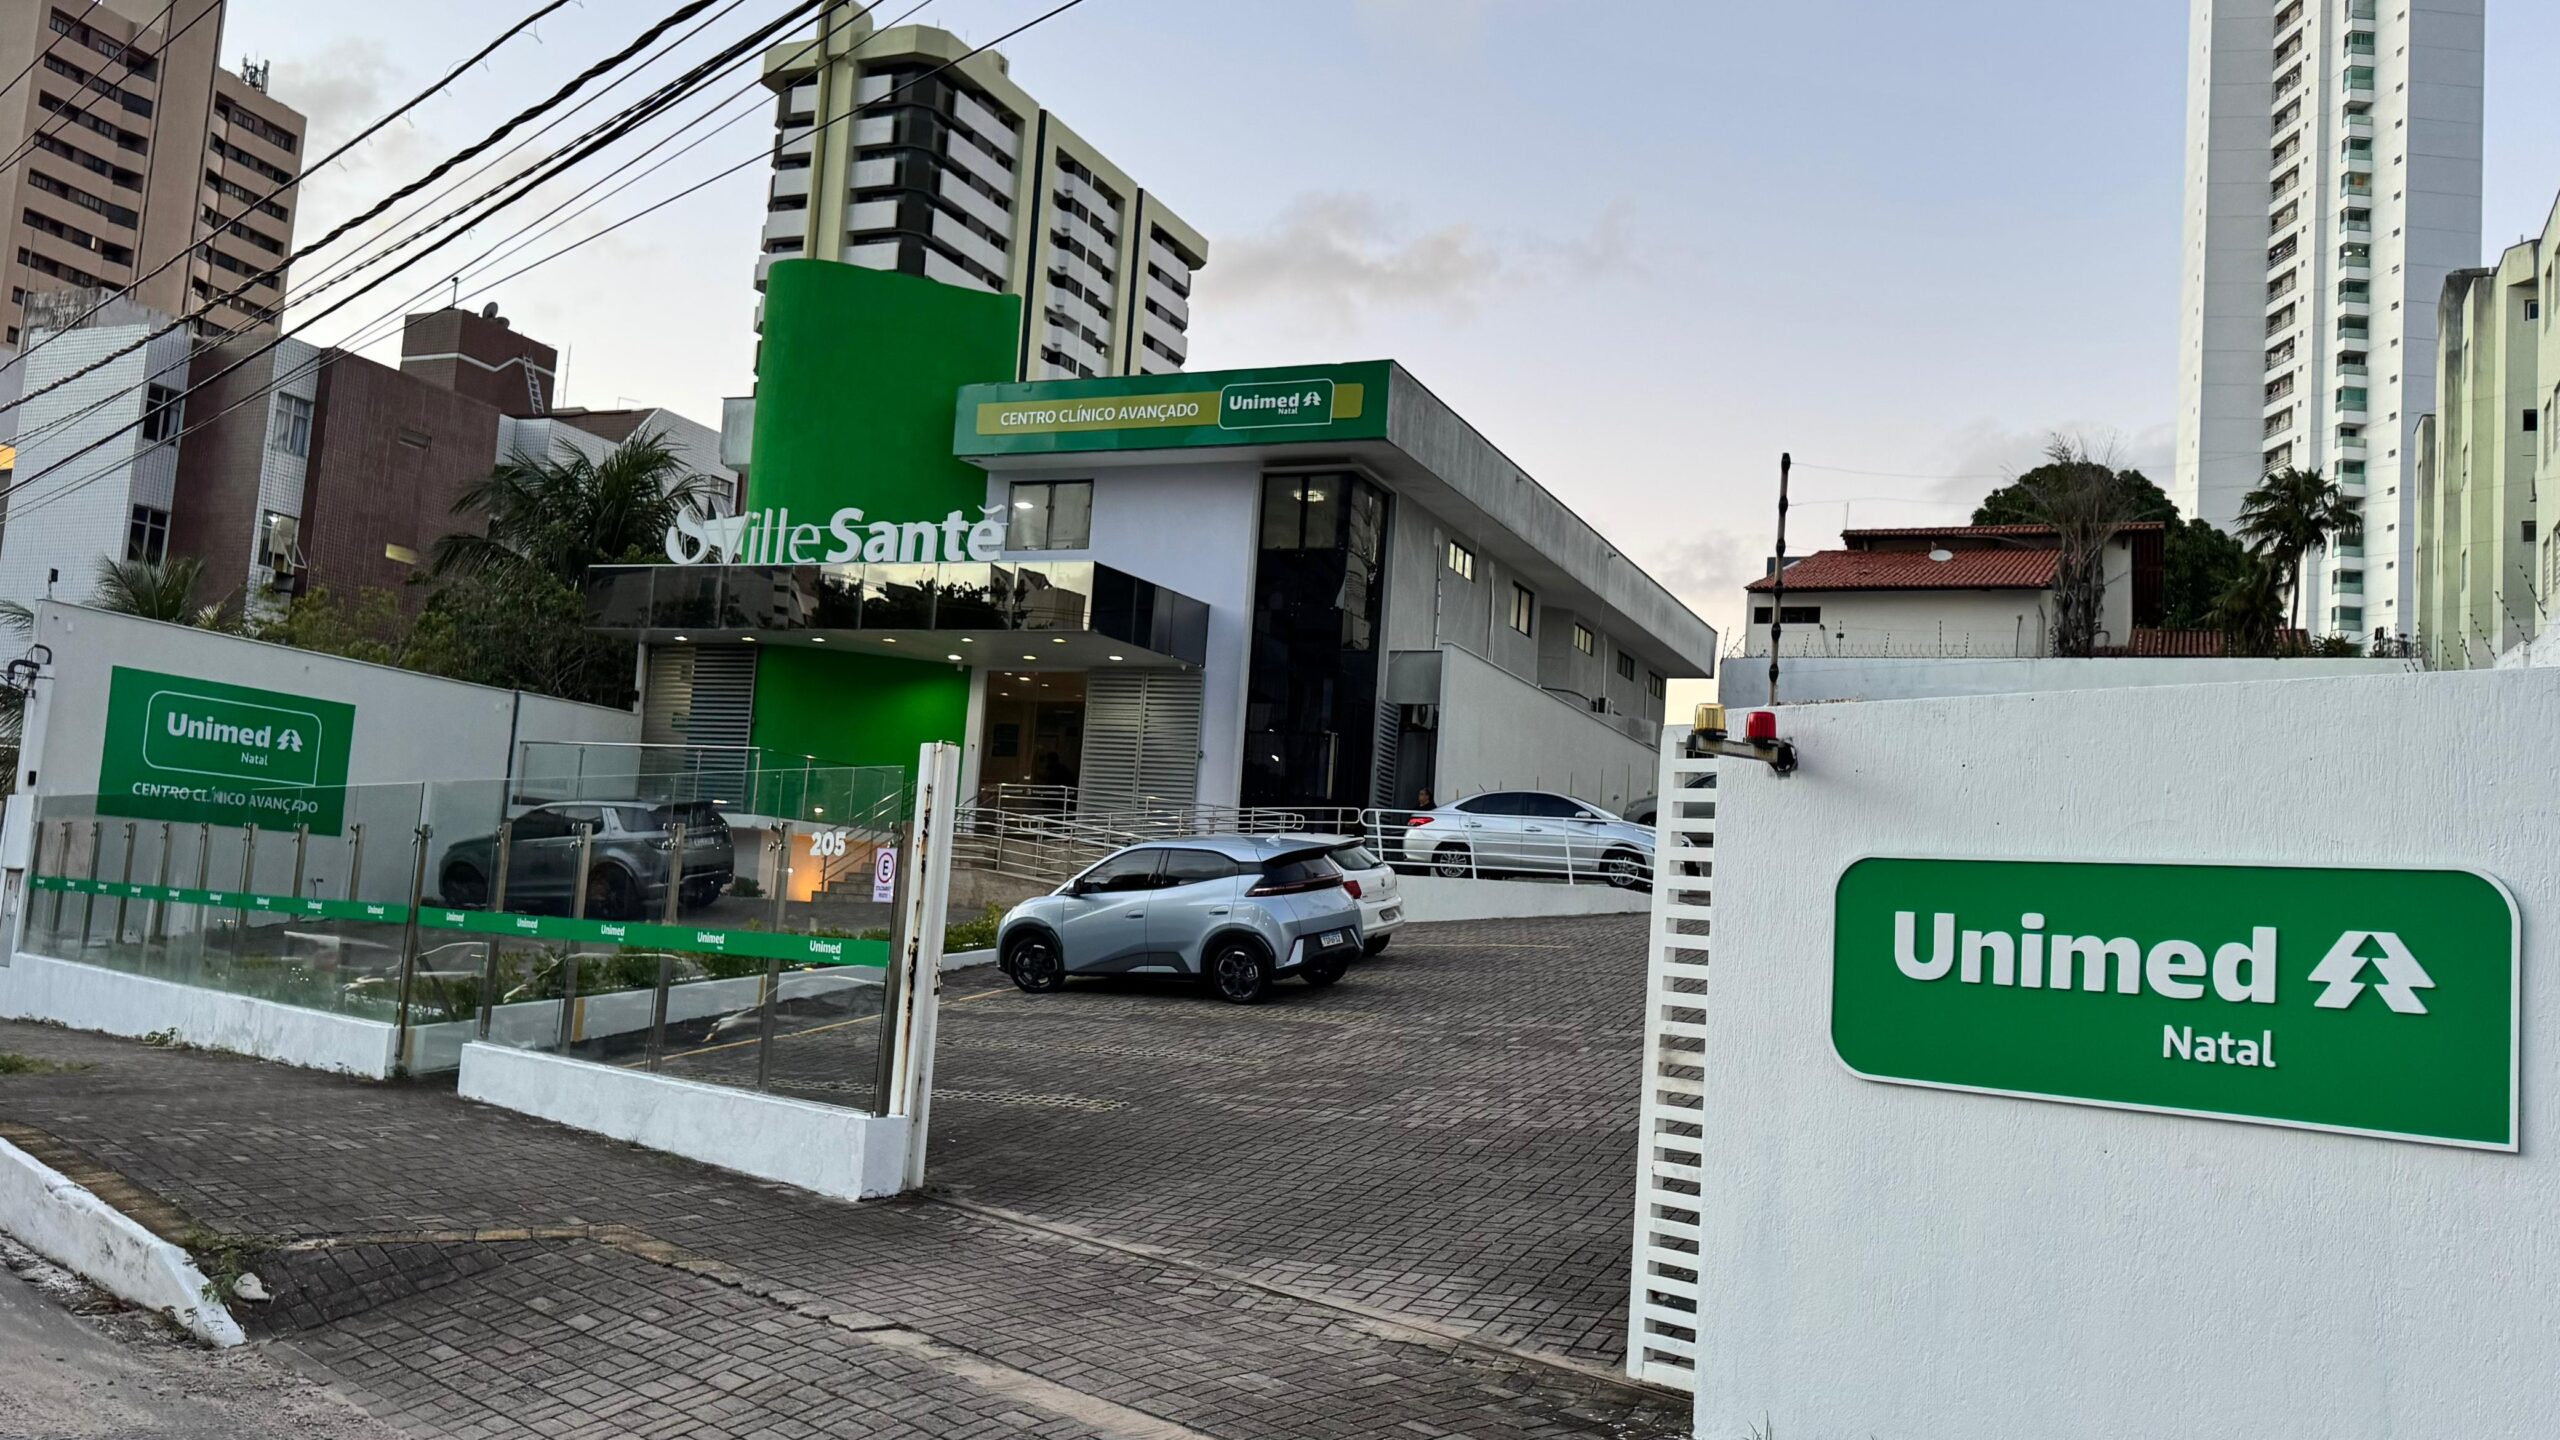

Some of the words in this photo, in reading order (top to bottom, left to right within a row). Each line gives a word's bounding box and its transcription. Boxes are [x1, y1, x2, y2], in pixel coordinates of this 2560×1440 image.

[1229, 392, 1300, 410] Unimed
[1000, 410, 1056, 426] CENTRO
[1059, 404, 1116, 423] CLÍNICO
[1118, 402, 1199, 422] AVANÇADO
[1277, 407, 1298, 415] Natal
[167, 711, 272, 749] Unimed
[240, 752, 268, 766] Natal
[132, 782, 190, 800] CENTRO
[809, 831, 847, 857] 205
[882, 860, 890, 876] E
[601, 924, 625, 937] Unimed
[697, 931, 725, 945] Unimed
[809, 940, 842, 954] Unimed
[1893, 911, 2277, 1005] Unimed
[2162, 1024, 2277, 1069] Natal
